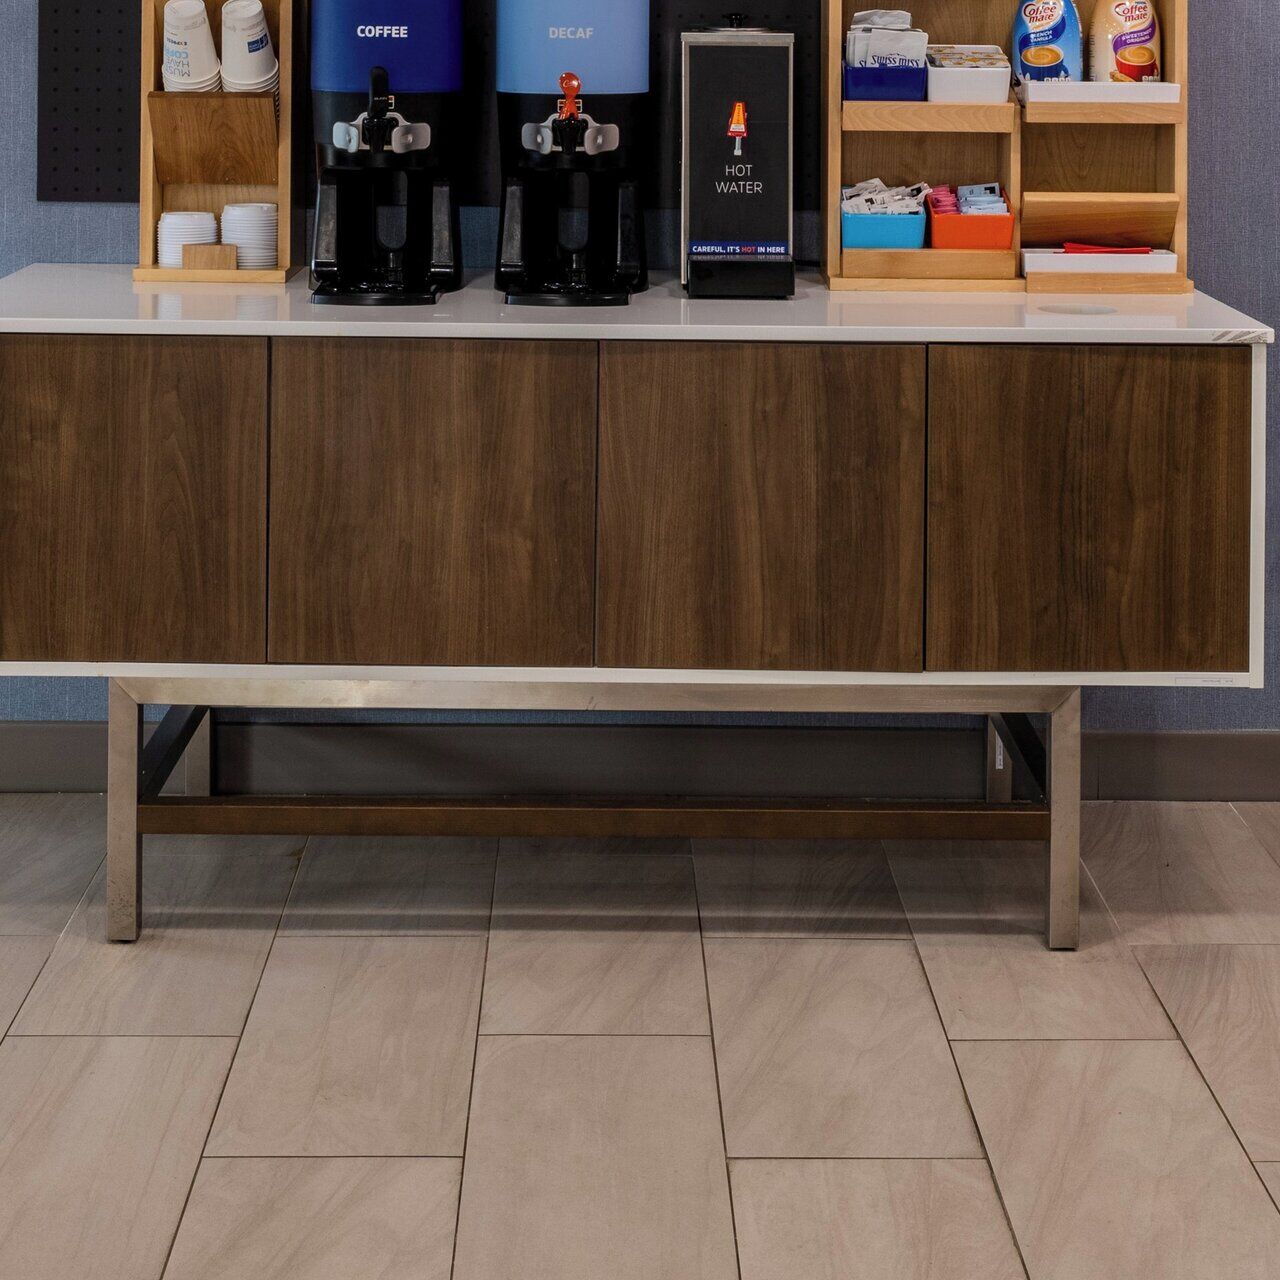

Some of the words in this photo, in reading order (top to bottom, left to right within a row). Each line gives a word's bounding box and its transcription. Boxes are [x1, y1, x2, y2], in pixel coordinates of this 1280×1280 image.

[357, 25, 408, 37] COFFEE
[548, 27, 594, 39] DECAF
[725, 164, 753, 176] HOT
[715, 181, 763, 193] WATER
[692, 245, 726, 253] CAREFUL,
